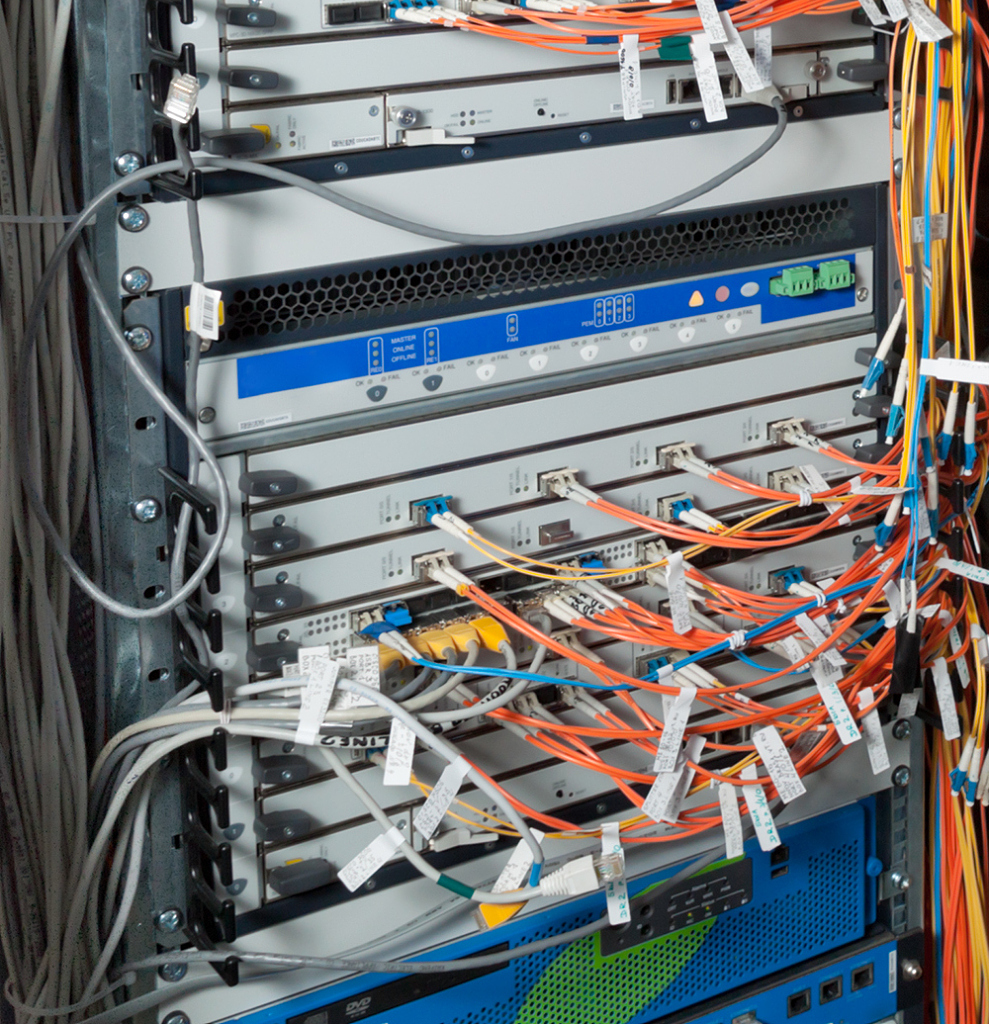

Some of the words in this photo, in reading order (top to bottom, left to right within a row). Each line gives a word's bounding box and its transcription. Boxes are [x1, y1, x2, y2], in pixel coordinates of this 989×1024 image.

[391, 335, 416, 344] MASTER
[392, 344, 415, 353] ONLINE
[391, 353, 416, 363] OFFLINE
[346, 996, 371, 1012] DVD
